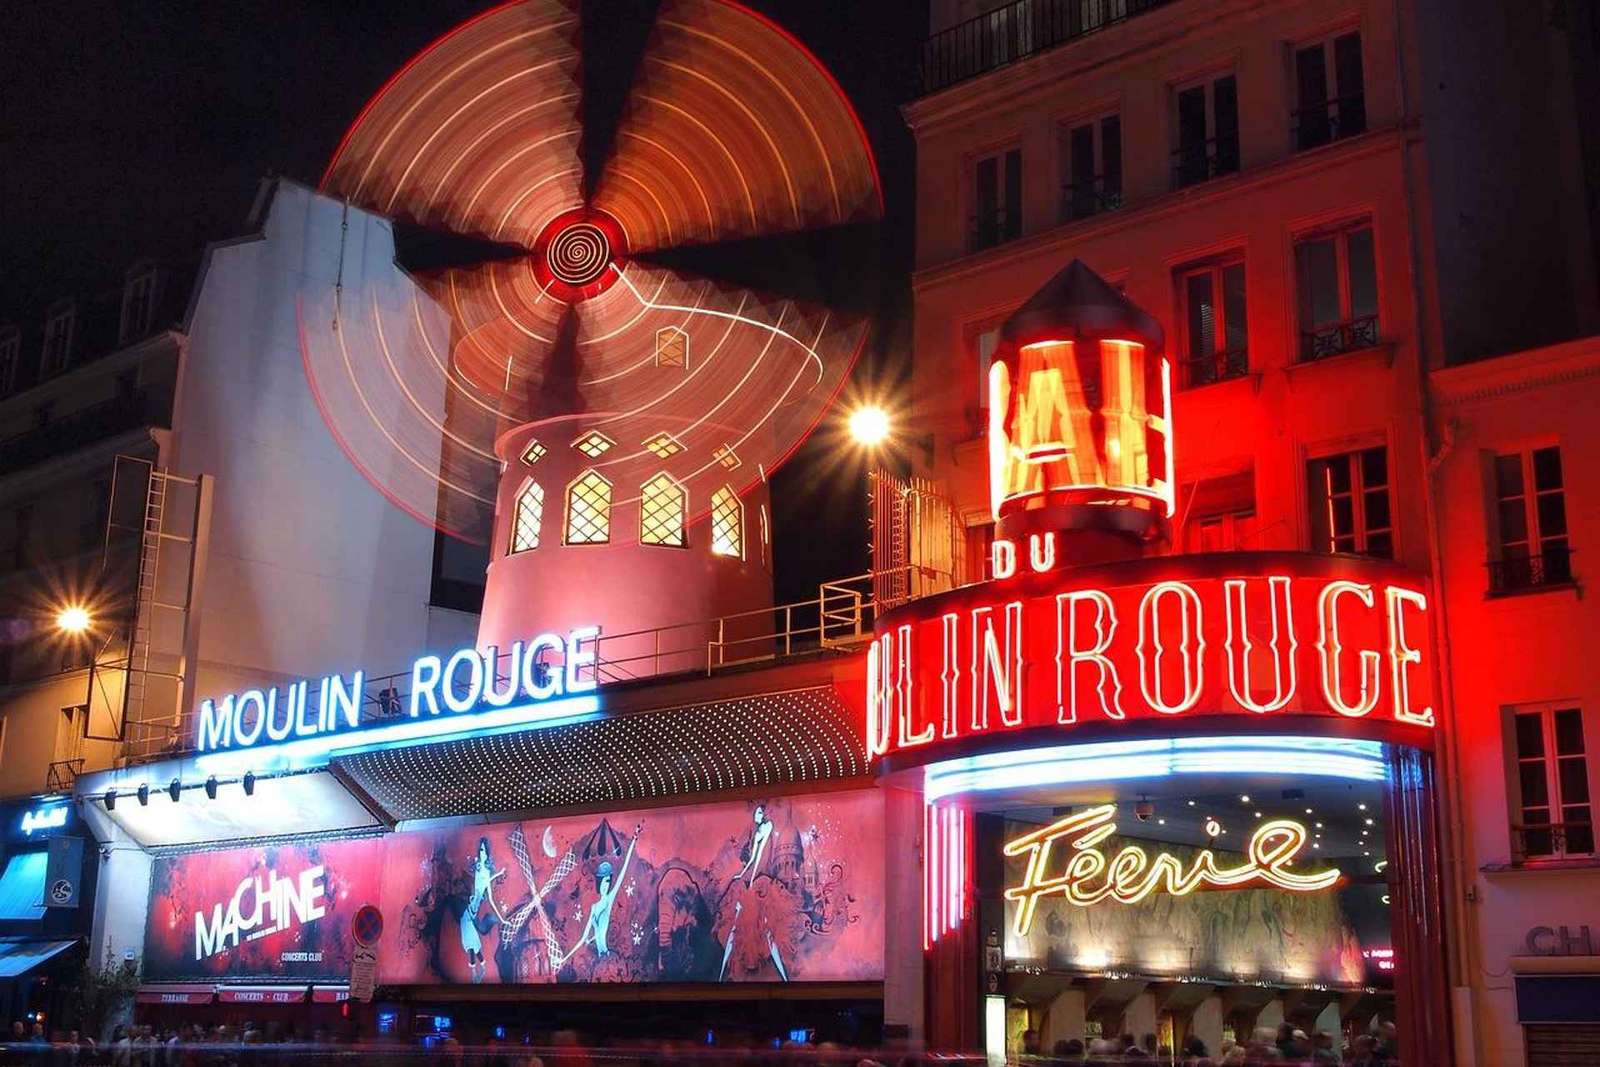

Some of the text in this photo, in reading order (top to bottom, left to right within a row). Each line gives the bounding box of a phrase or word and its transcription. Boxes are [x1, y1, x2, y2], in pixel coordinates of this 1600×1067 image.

[991, 532, 1056, 580] DU
[196, 626, 602, 751] MOULIN ROUGE
[1055, 576, 1436, 728] ROUGE
[194, 865, 326, 961] MACHINE
[1003, 803, 1341, 937] Féerie
[280, 952, 323, 962] CONCERTS CLUB
